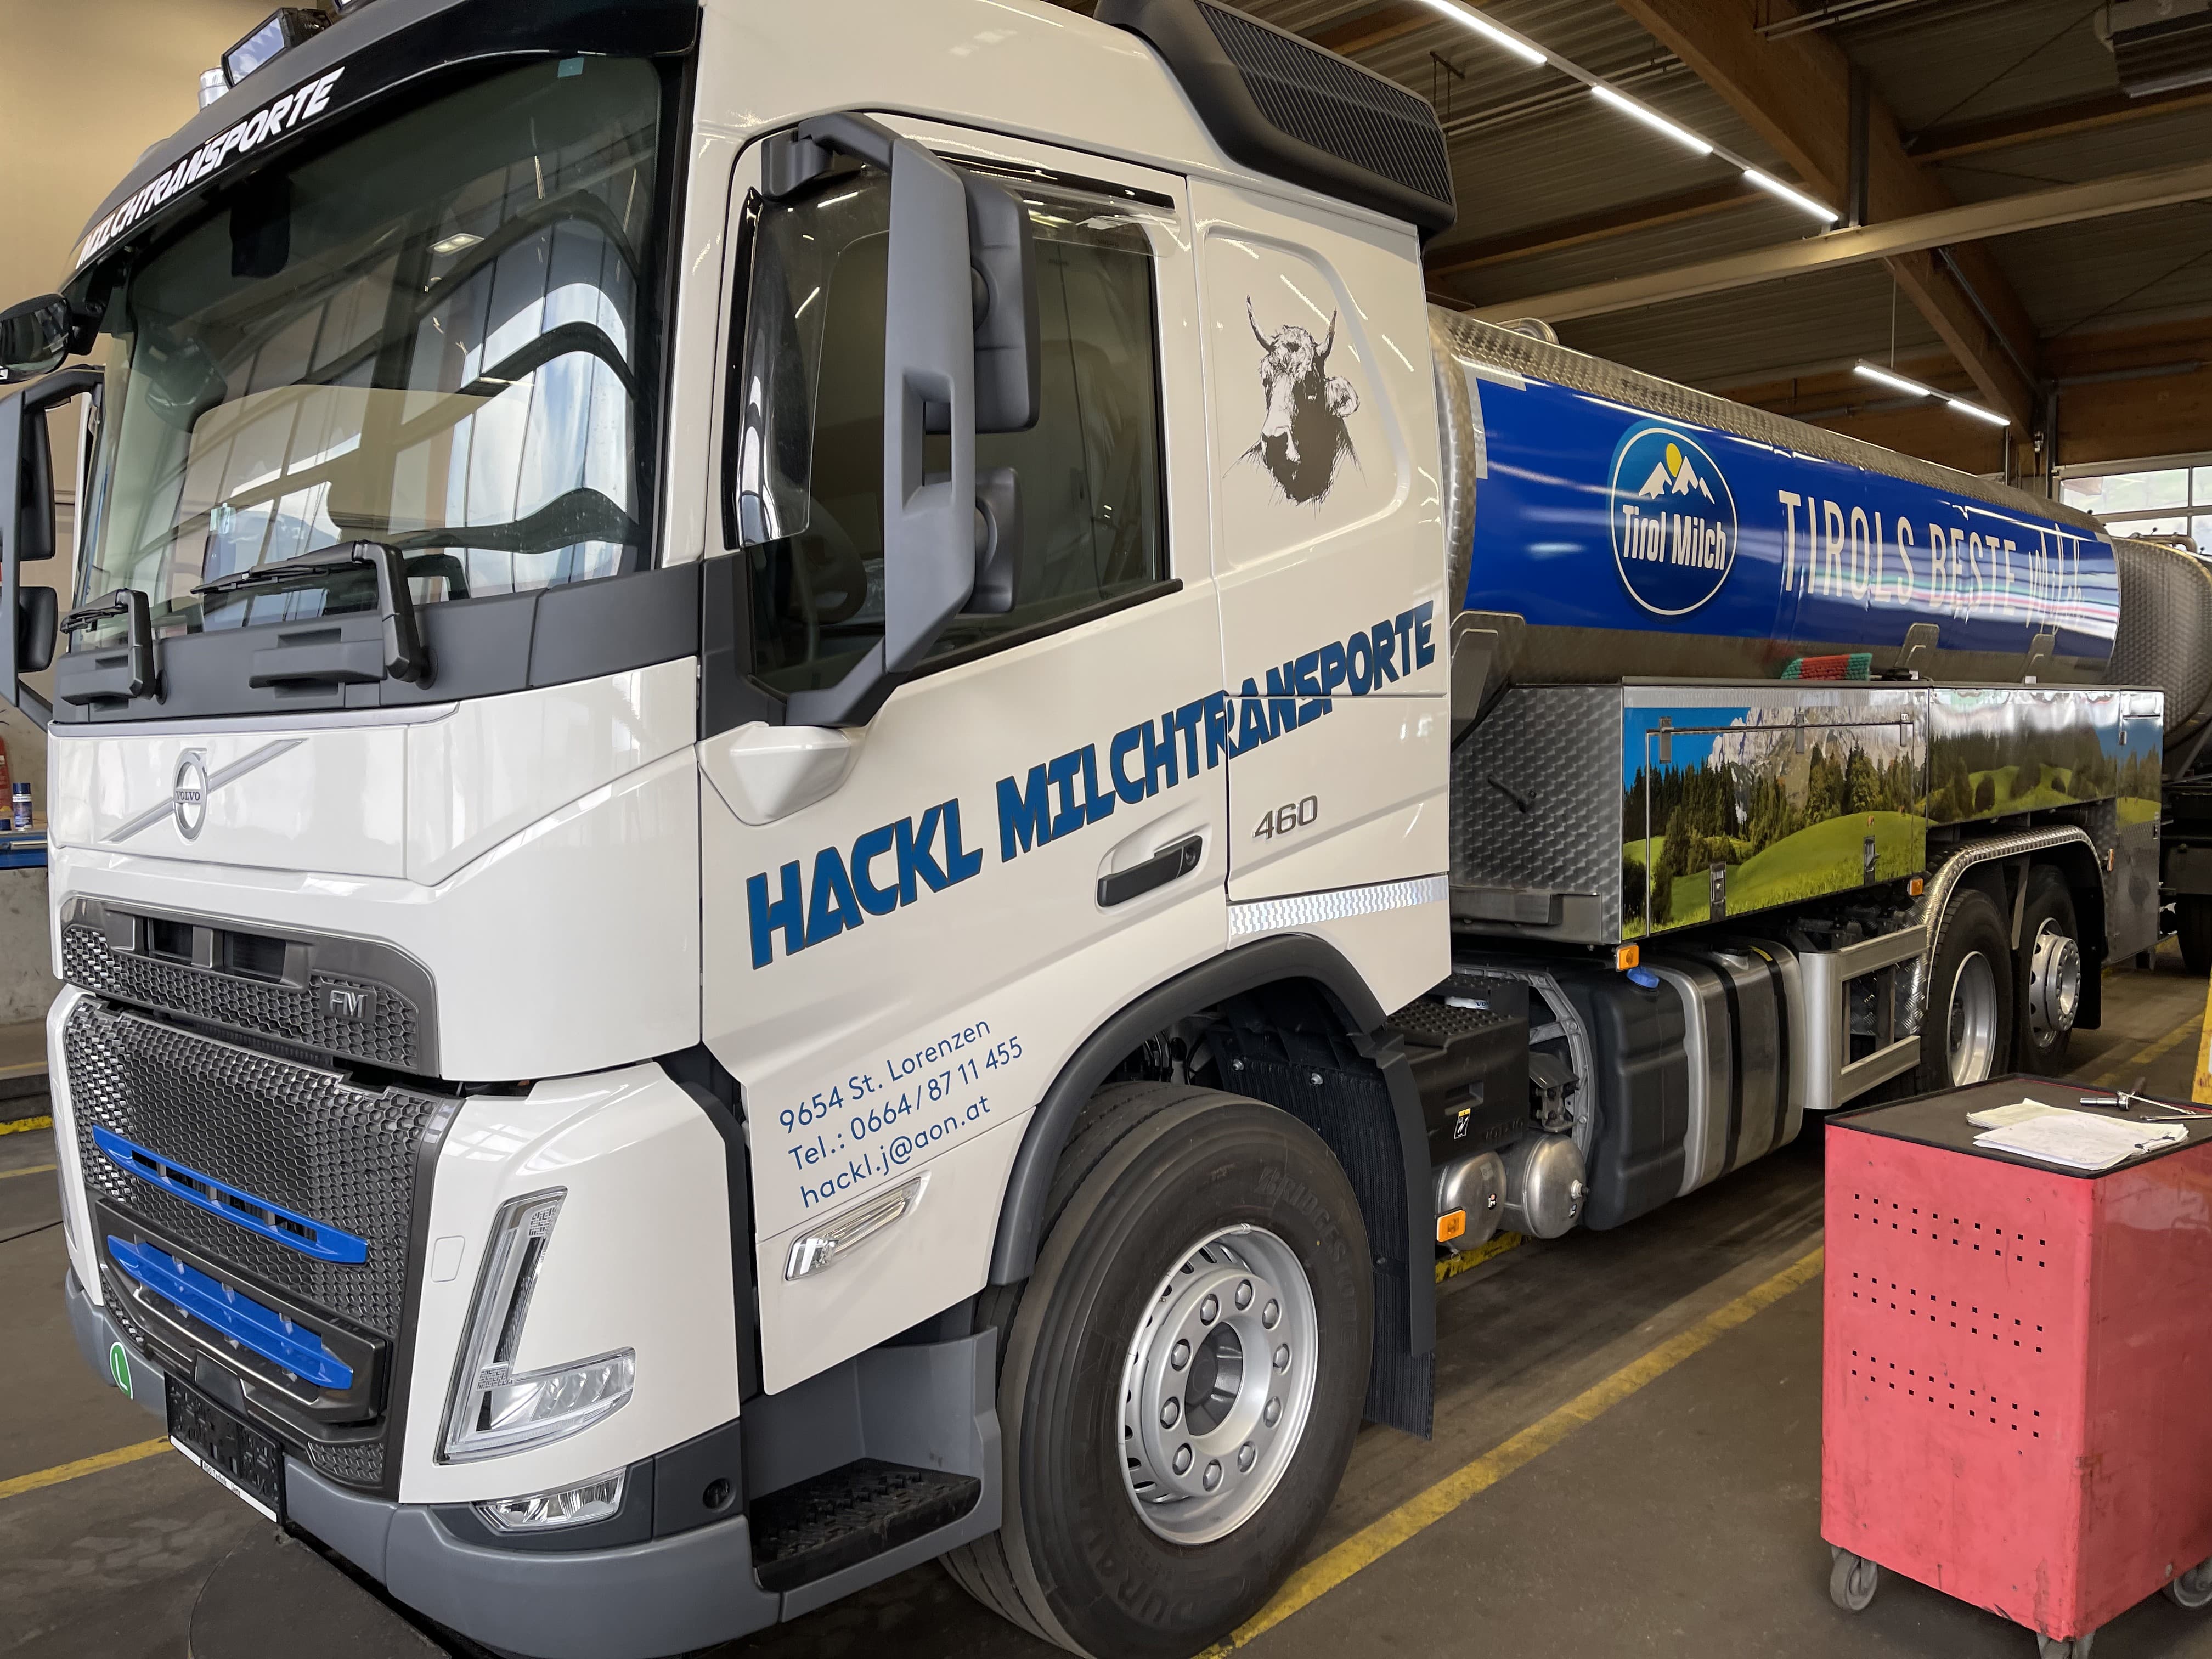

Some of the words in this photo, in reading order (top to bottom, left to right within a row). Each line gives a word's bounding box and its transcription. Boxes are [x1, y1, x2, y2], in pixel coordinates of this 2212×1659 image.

[75, 66, 345, 270] MILCHTRANSPORTE
[1622, 504, 1667, 563] Tirol
[1671, 514, 1727, 571] Milch
[1778, 490, 1914, 605] TIROLS
[1928, 523, 2017, 618] BESTE
[175, 791, 201, 801] VOLVO
[745, 798, 983, 970] HACKL
[995, 600, 1436, 863] MILCHTRANSPORTE
[1252, 795, 1318, 840] 460
[330, 990, 368, 1019] FM
[779, 1085, 844, 1134] 9654
[848, 1074, 883, 1101] St.
[886, 1020, 991, 1082] Lorenzen
[788, 1132, 845, 1171] Tel.:
[985, 1035, 1023, 1070] 455
[800, 1096, 991, 1209] hackl.j@aon.at
[114, 1352, 128, 1391] L
